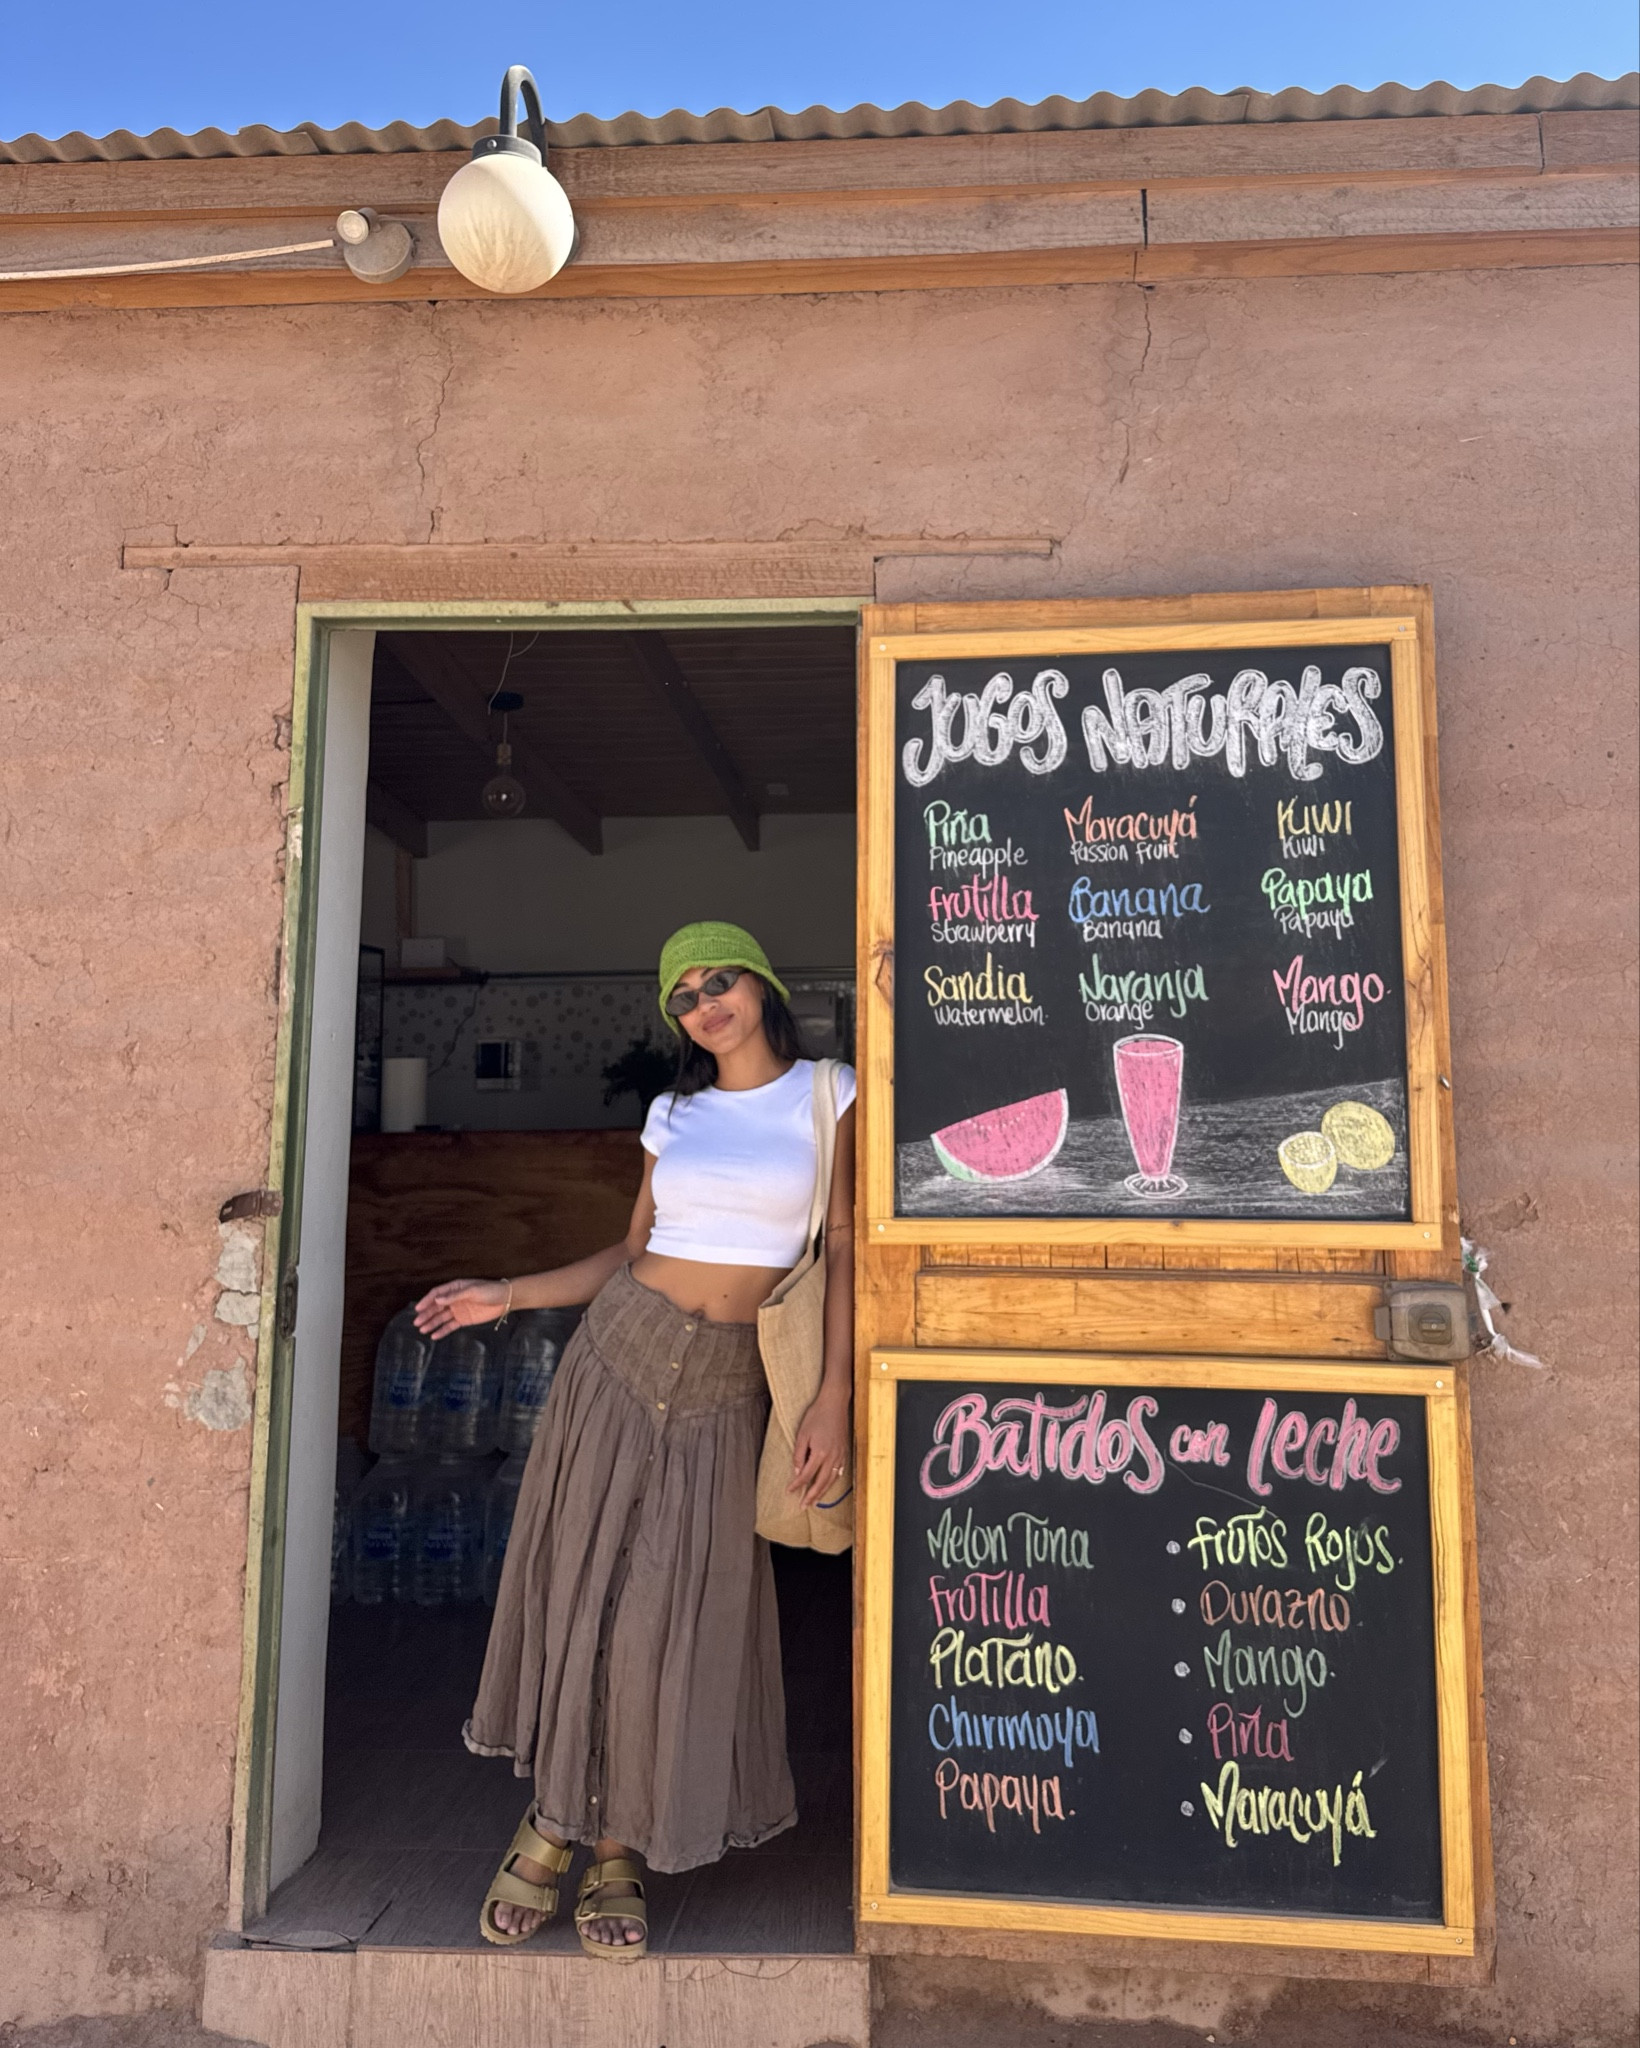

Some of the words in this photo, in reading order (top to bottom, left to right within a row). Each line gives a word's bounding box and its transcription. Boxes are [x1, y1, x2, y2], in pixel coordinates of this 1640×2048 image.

[923, 800, 993, 847] Piña
[1064, 795, 1198, 854] Maracuyá
[929, 837, 1028, 880] Pineapple
[1070, 840, 1129, 865] Passion
[1069, 876, 1211, 923] Banana
[1261, 867, 1373, 920] Papaya
[930, 918, 1035, 948] Strawberry
[1083, 919, 1163, 943] Banana
[1274, 904, 1354, 940] Papaya
[1079, 953, 1209, 1018] Naranja
[1085, 1000, 1154, 1030] Orange
[1285, 1002, 1356, 1050] Mango
[926, 1507, 1008, 1569] Melon
[1007, 1511, 1094, 1569] Tuna
[928, 1694, 1100, 1768] Chirimoya
[1206, 1702, 1294, 1762] Piña
[1200, 1760, 1376, 1867] Maracuyá
